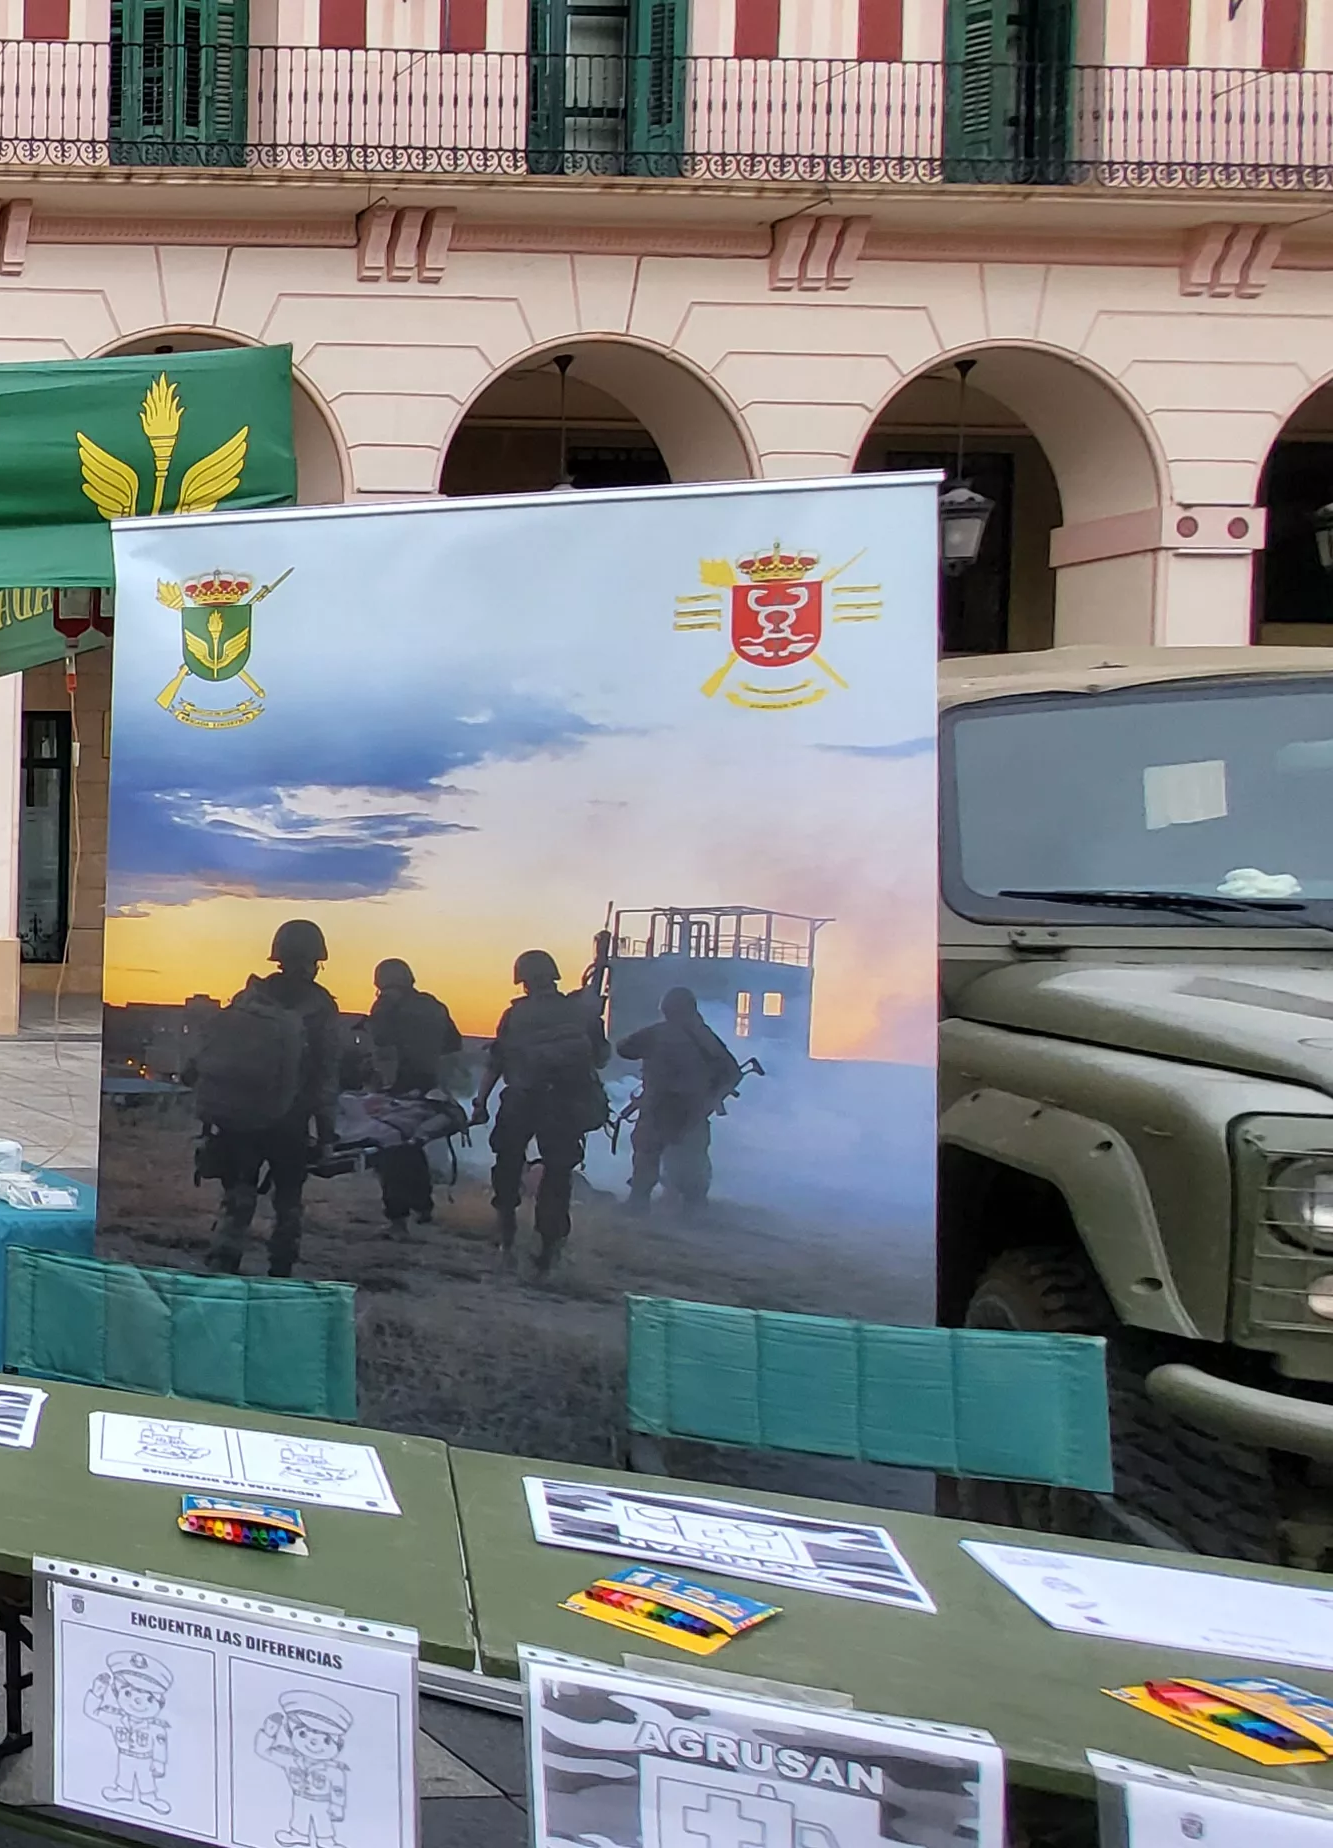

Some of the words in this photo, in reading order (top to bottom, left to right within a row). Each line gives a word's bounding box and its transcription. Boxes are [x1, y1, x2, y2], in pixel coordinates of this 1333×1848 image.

[130, 1611, 213, 1641] ENCUENTRA
[215, 1627, 242, 1648] LAS
[245, 1634, 343, 1670] DIFERENCIAS
[633, 1719, 885, 1796] AGRUSAN
